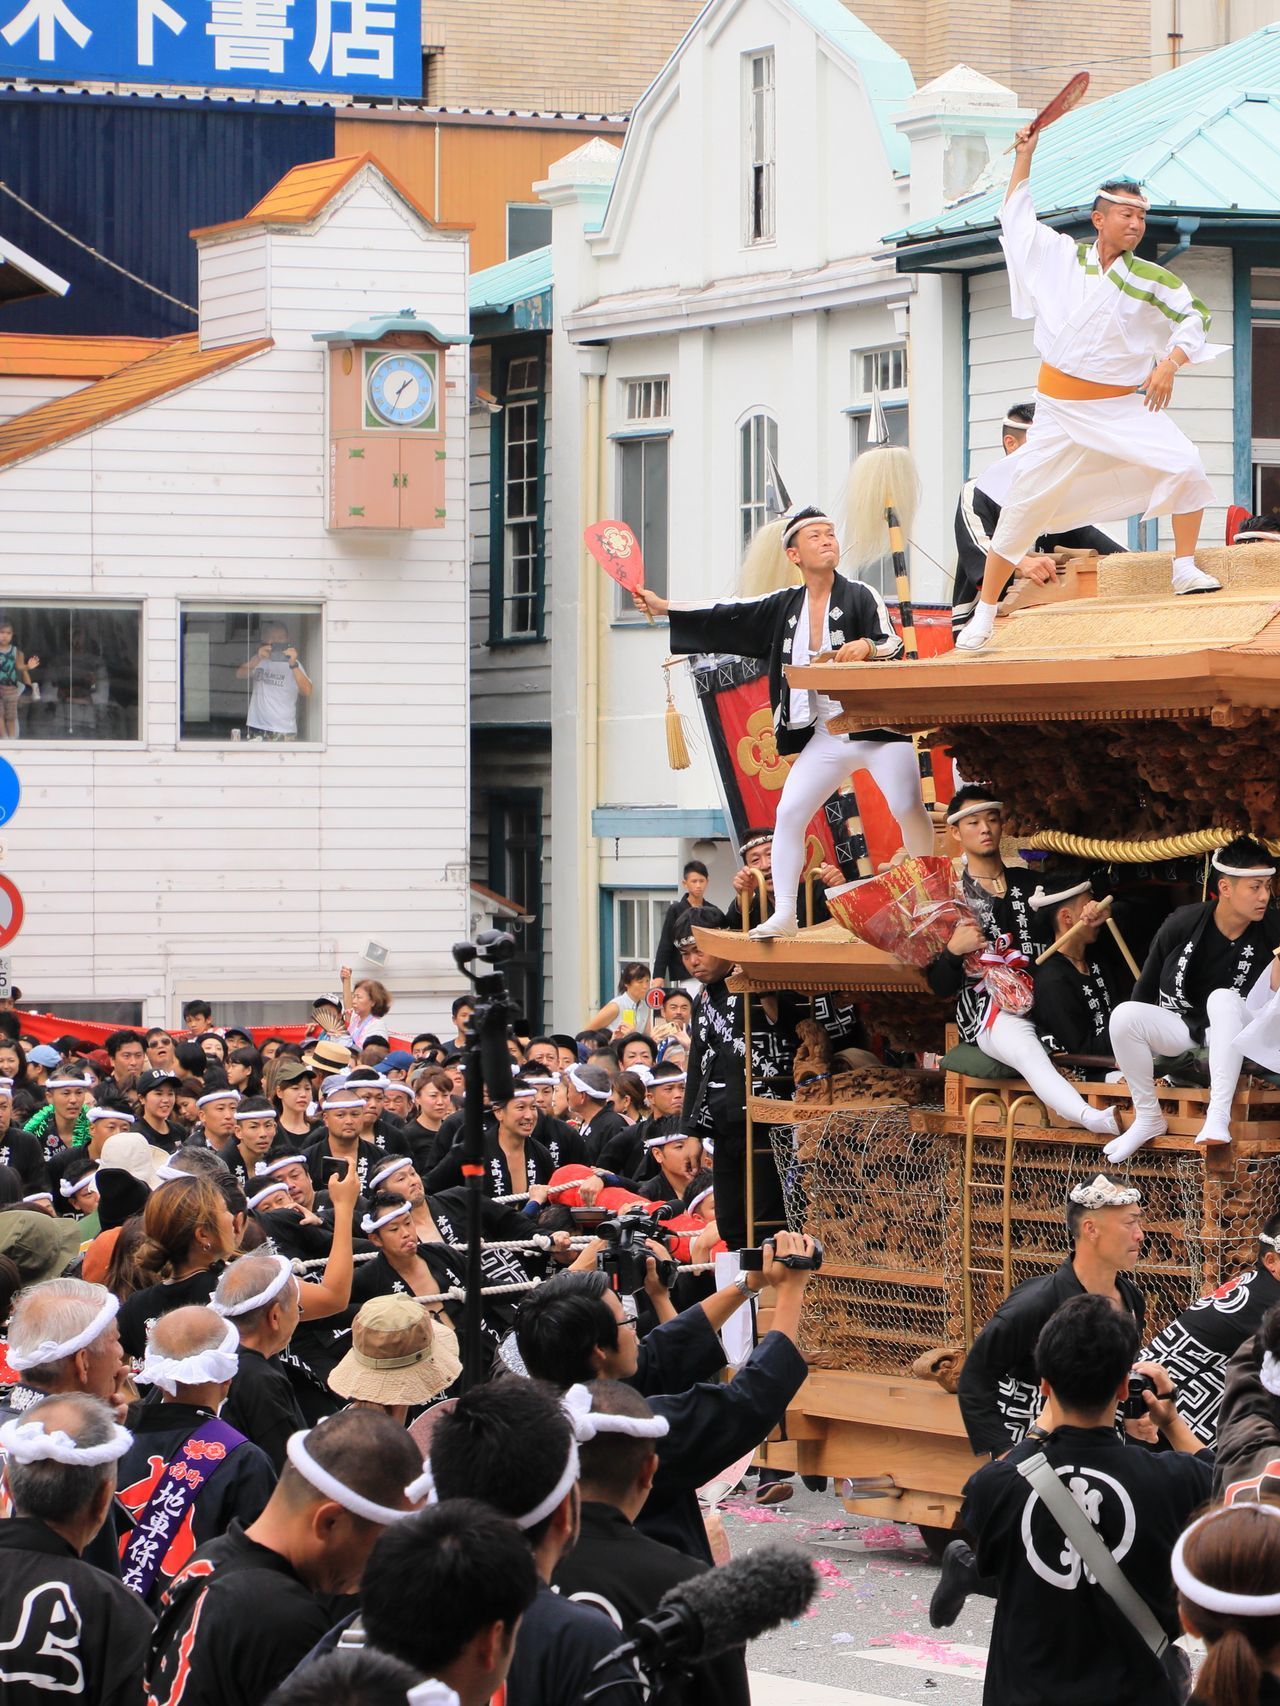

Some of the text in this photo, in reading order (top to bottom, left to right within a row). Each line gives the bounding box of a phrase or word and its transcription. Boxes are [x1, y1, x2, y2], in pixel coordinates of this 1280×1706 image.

[1010, 886, 1034, 955] 本町青年団
[121, 1480, 187, 1594] 地車保存
